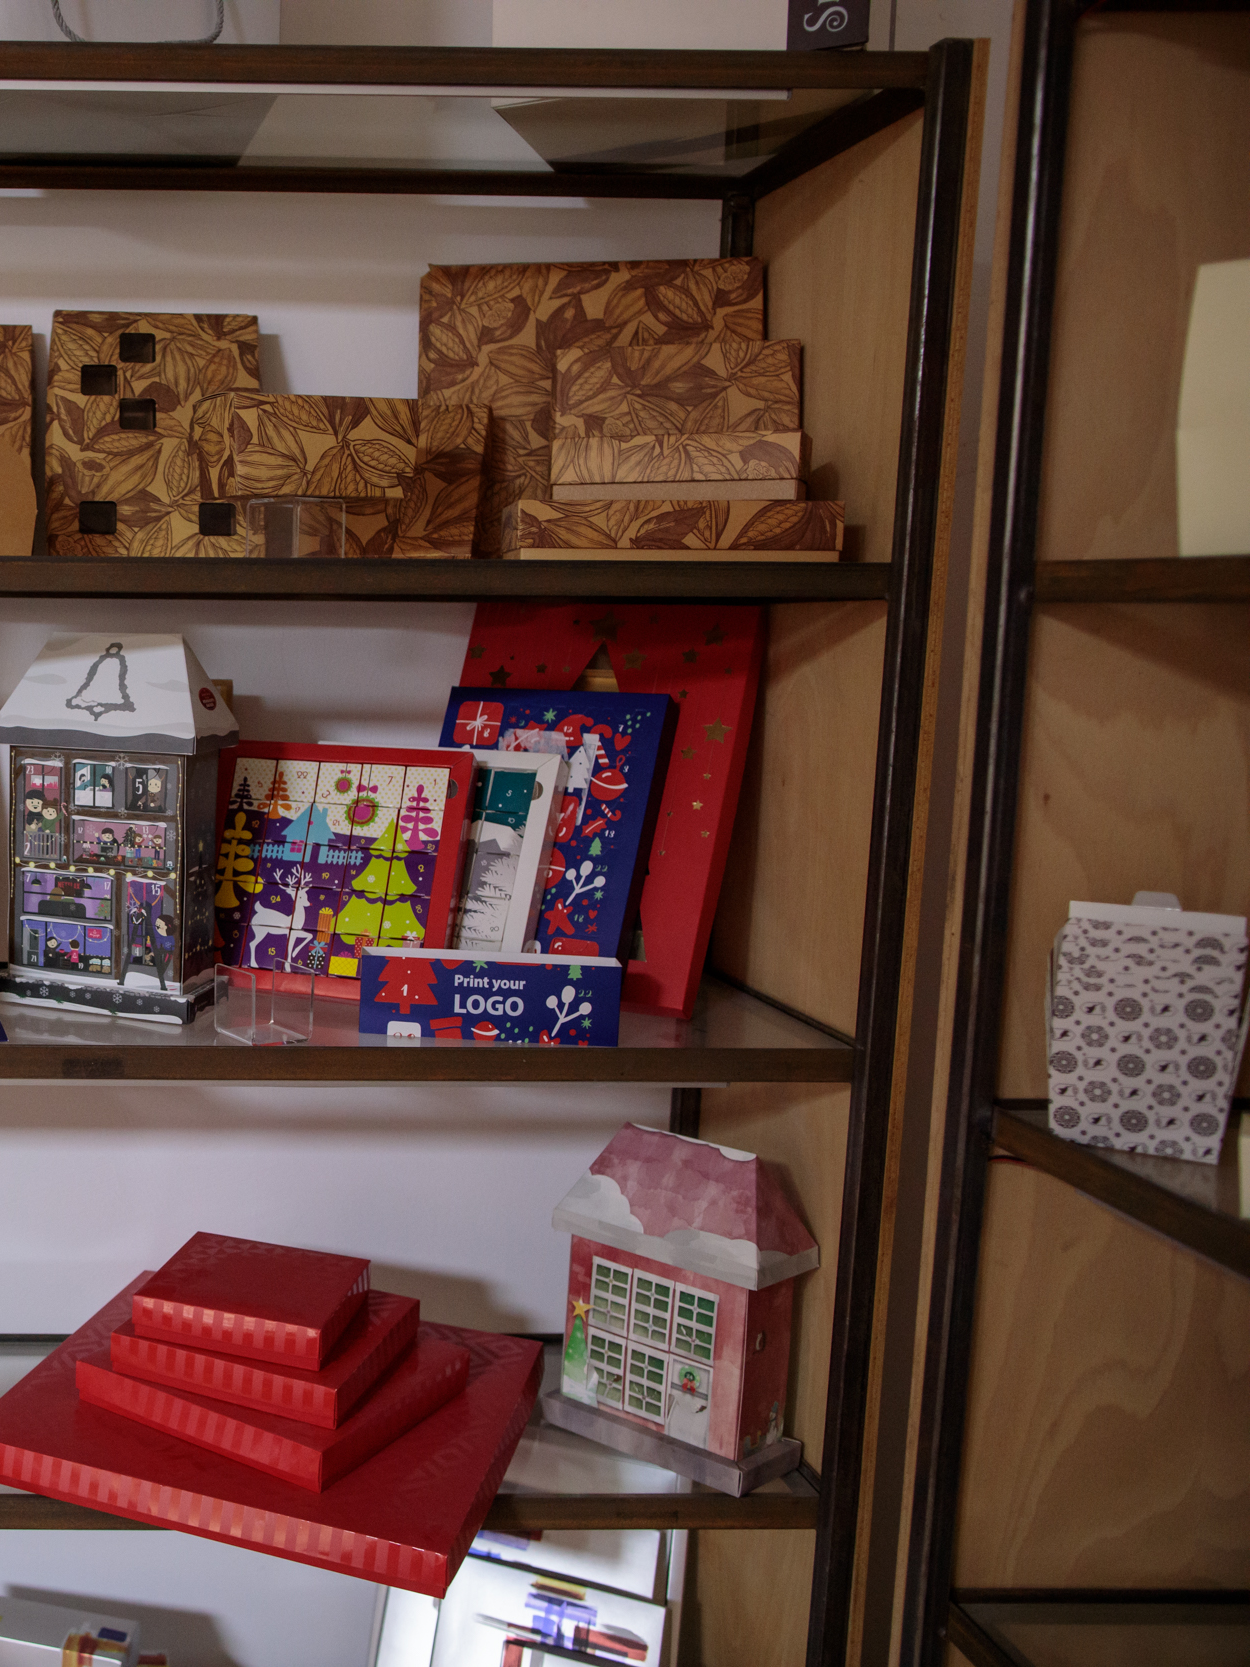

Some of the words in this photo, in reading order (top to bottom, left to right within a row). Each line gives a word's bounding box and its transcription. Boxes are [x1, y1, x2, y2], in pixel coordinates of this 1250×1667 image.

[483, 728, 491, 738] 8
[618, 724, 625, 733] 7
[26, 765, 35, 775] 23
[296, 770, 309, 780] 22
[387, 775, 394, 786] 7
[134, 778, 143, 795] 5
[505, 789, 513, 797] 5
[332, 819, 340, 827] 21
[417, 864, 425, 873] 2
[594, 864, 608, 873] 22
[25, 873, 32, 883] 7
[321, 871, 330, 880] 19
[104, 881, 112, 891] 17
[150, 883, 160, 896] 15
[270, 895, 282, 904] 24
[489, 925, 500, 933] 20
[268, 947, 276, 956] 15
[453, 974, 490, 989] Print
[492, 977, 527, 992] your
[401, 984, 408, 997] 1
[577, 989, 593, 998] 22
[453, 994, 525, 1017] LOGO
